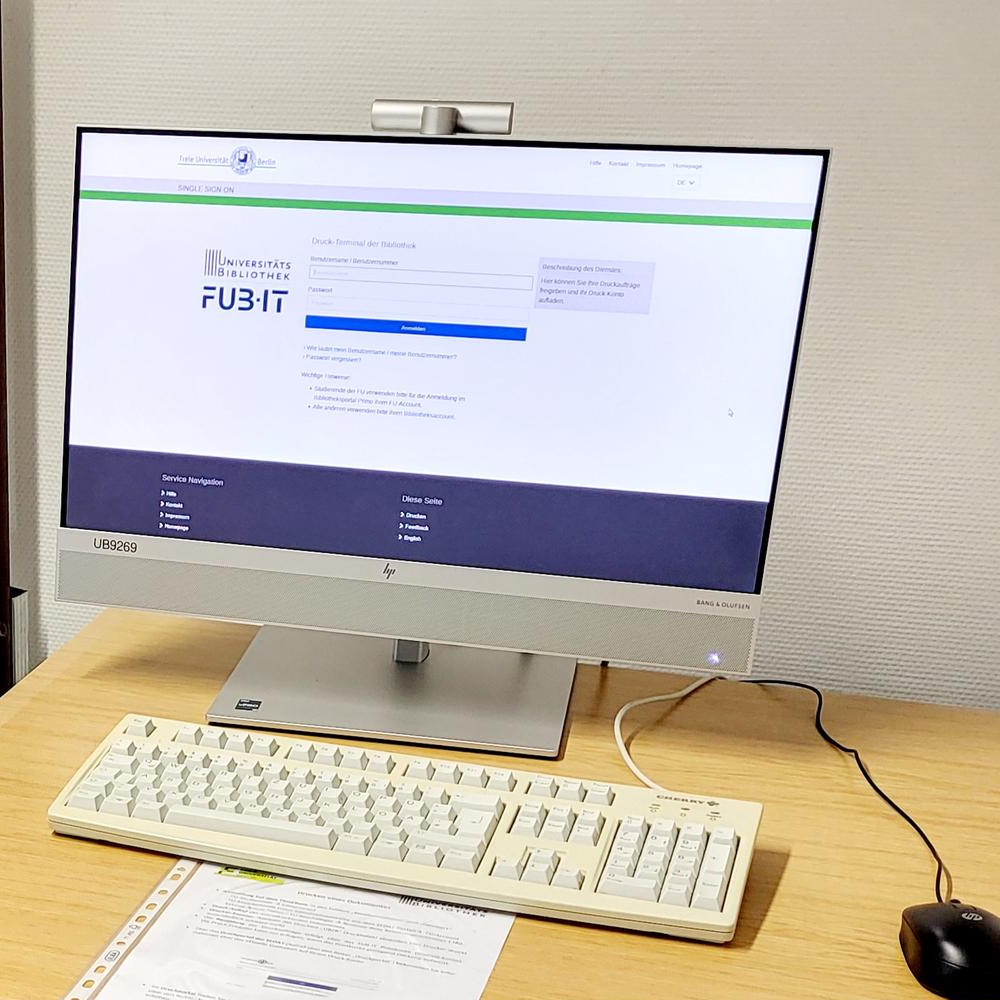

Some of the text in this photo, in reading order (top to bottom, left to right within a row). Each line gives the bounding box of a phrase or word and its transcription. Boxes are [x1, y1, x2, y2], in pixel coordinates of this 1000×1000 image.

[204, 185, 222, 193] SIGN
[223, 186, 235, 194] ON
[218, 249, 292, 270] UNIVERSITÄTS
[217, 267, 291, 281] BIBLIOTHEK
[161, 473, 224, 487] Service Navigation
[401, 495, 443, 506] Diese Seite
[93, 537, 138, 553] UB9269
[696, 599, 715, 607] BANG
[721, 602, 751, 610] OLUFSEN
[656, 794, 705, 805] CHERRY
